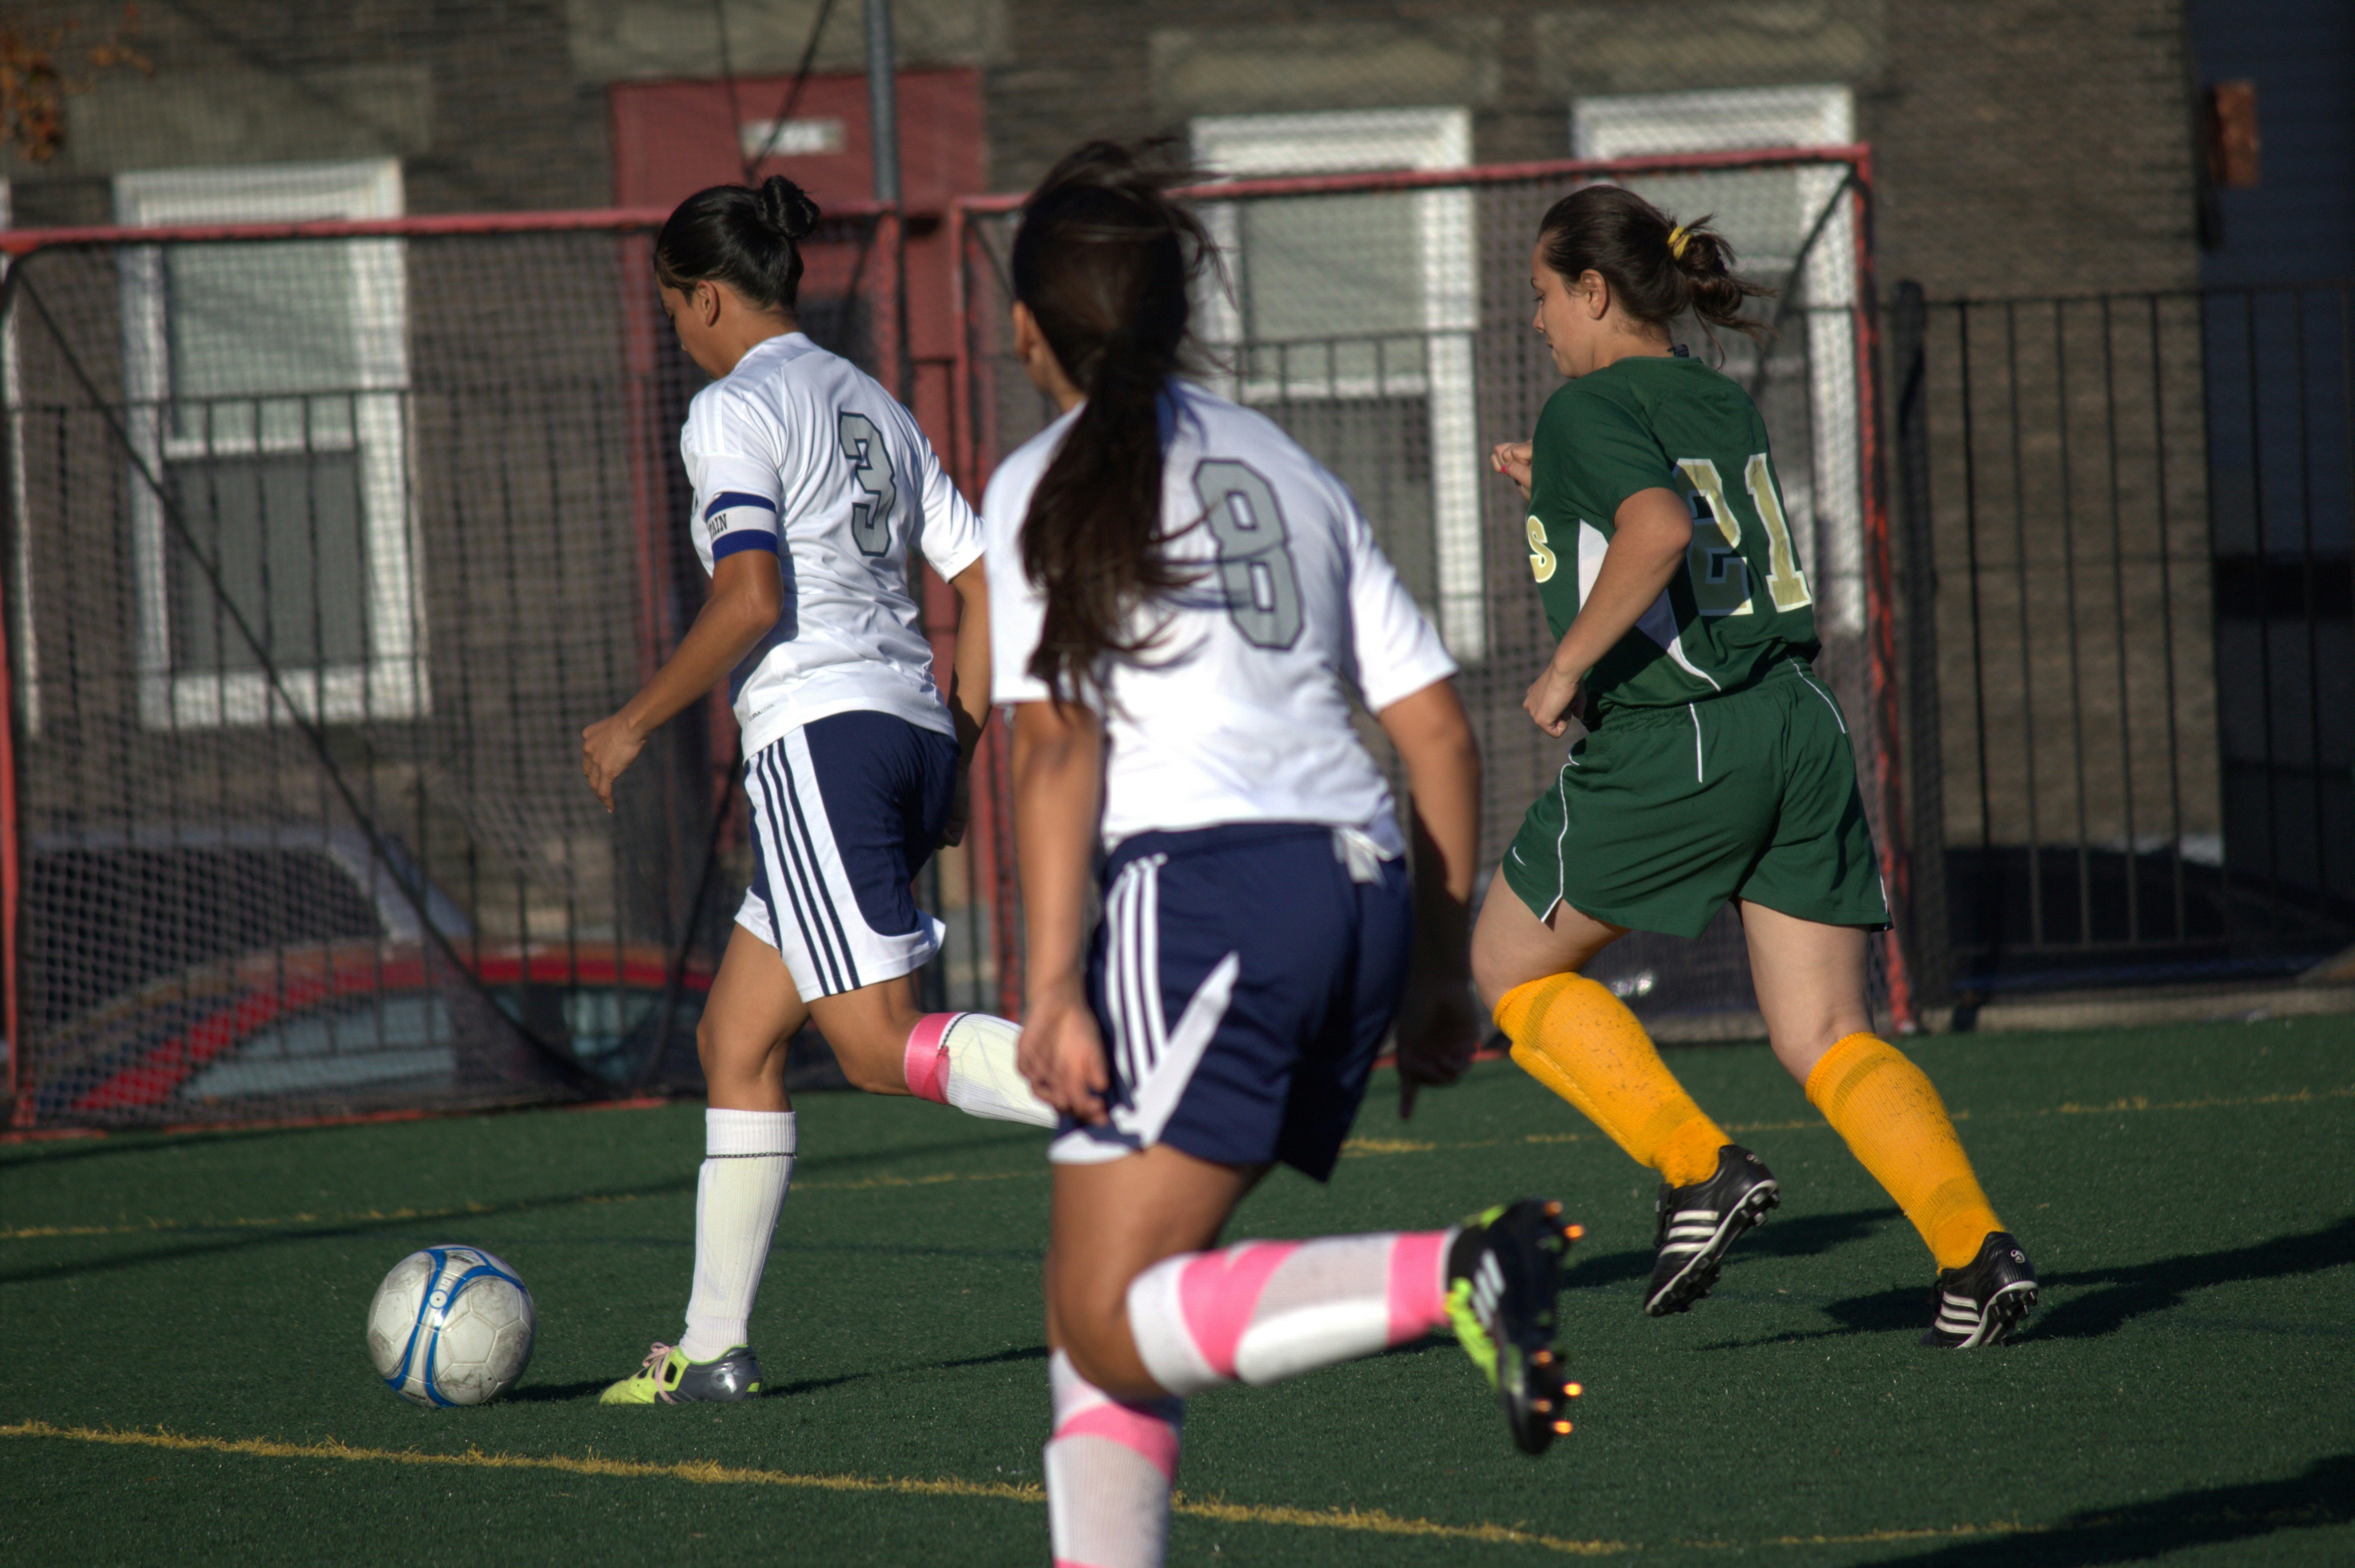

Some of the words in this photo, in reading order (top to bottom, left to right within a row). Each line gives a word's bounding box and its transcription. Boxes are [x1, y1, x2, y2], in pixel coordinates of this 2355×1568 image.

[708, 513, 728, 540] TAIN
[838, 411, 896, 557] 3
[1192, 457, 1305, 651] 8
[1672, 452, 1812, 616] 21
